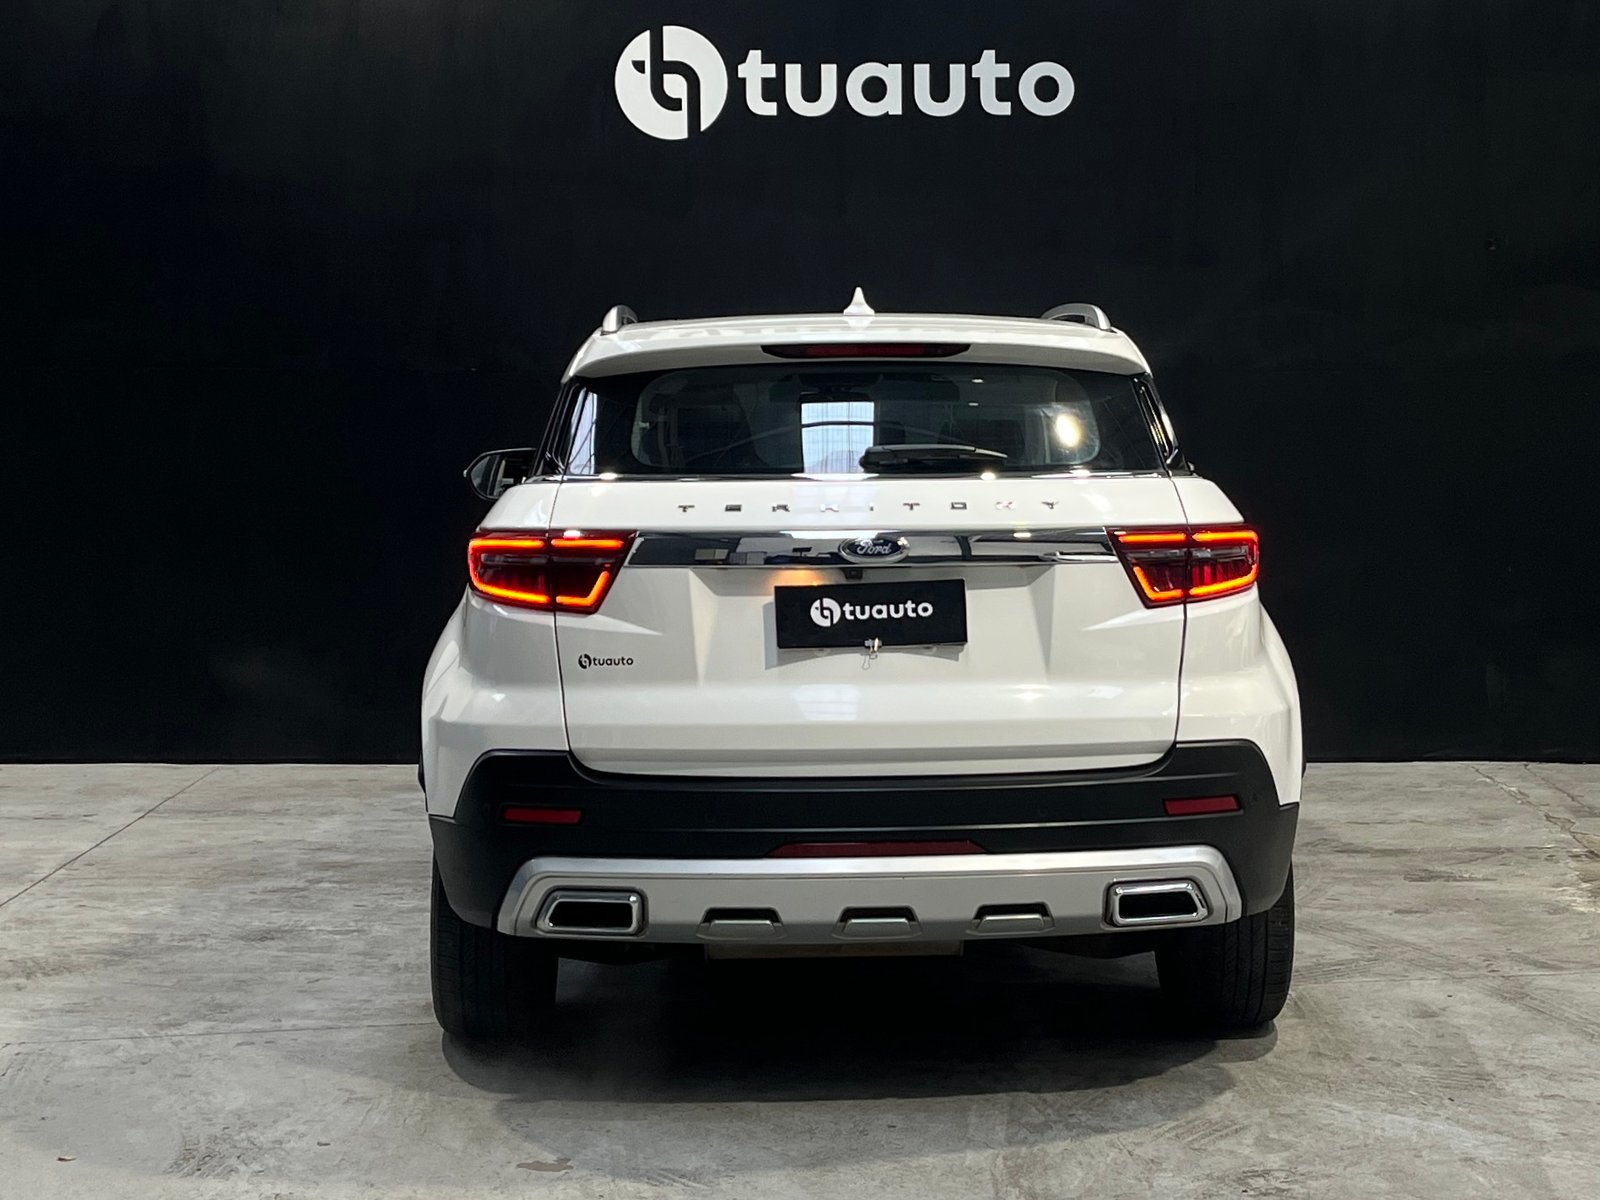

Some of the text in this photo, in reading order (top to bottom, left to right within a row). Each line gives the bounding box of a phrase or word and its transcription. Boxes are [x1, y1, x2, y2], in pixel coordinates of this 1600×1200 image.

[737, 49, 1075, 117] tuauto
[856, 539, 892, 555] Ford
[842, 600, 934, 620] tuauto
[592, 656, 634, 667] tuauto
